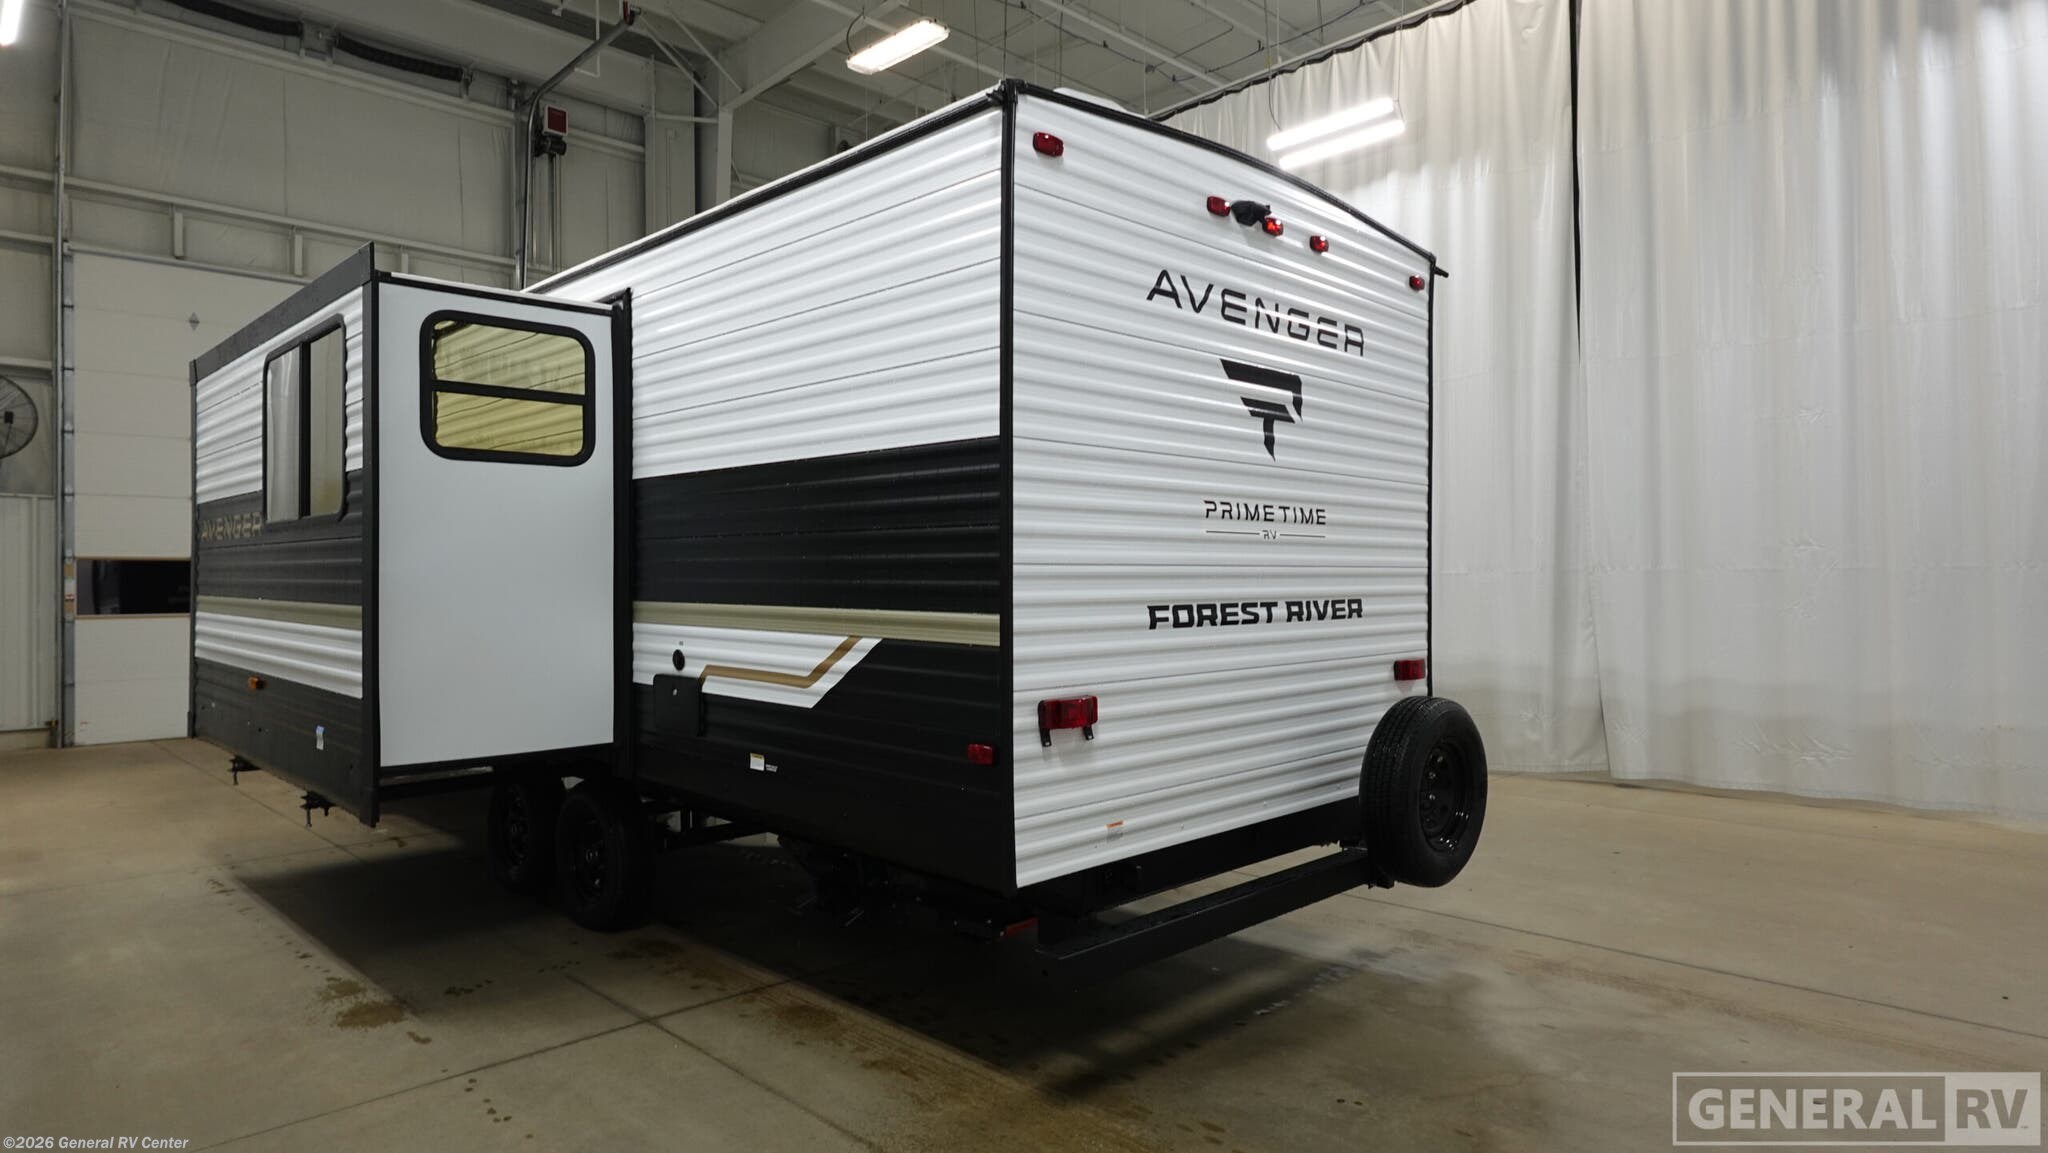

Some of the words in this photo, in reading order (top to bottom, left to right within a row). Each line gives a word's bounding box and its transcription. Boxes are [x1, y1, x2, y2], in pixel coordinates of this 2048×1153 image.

[1146, 269, 1365, 357] AVENGER
[201, 511, 263, 541] AVENGER
[1262, 530, 1277, 540] RV
[1147, 601, 1278, 630] FOREST
[1285, 598, 1363, 622] RIVER
